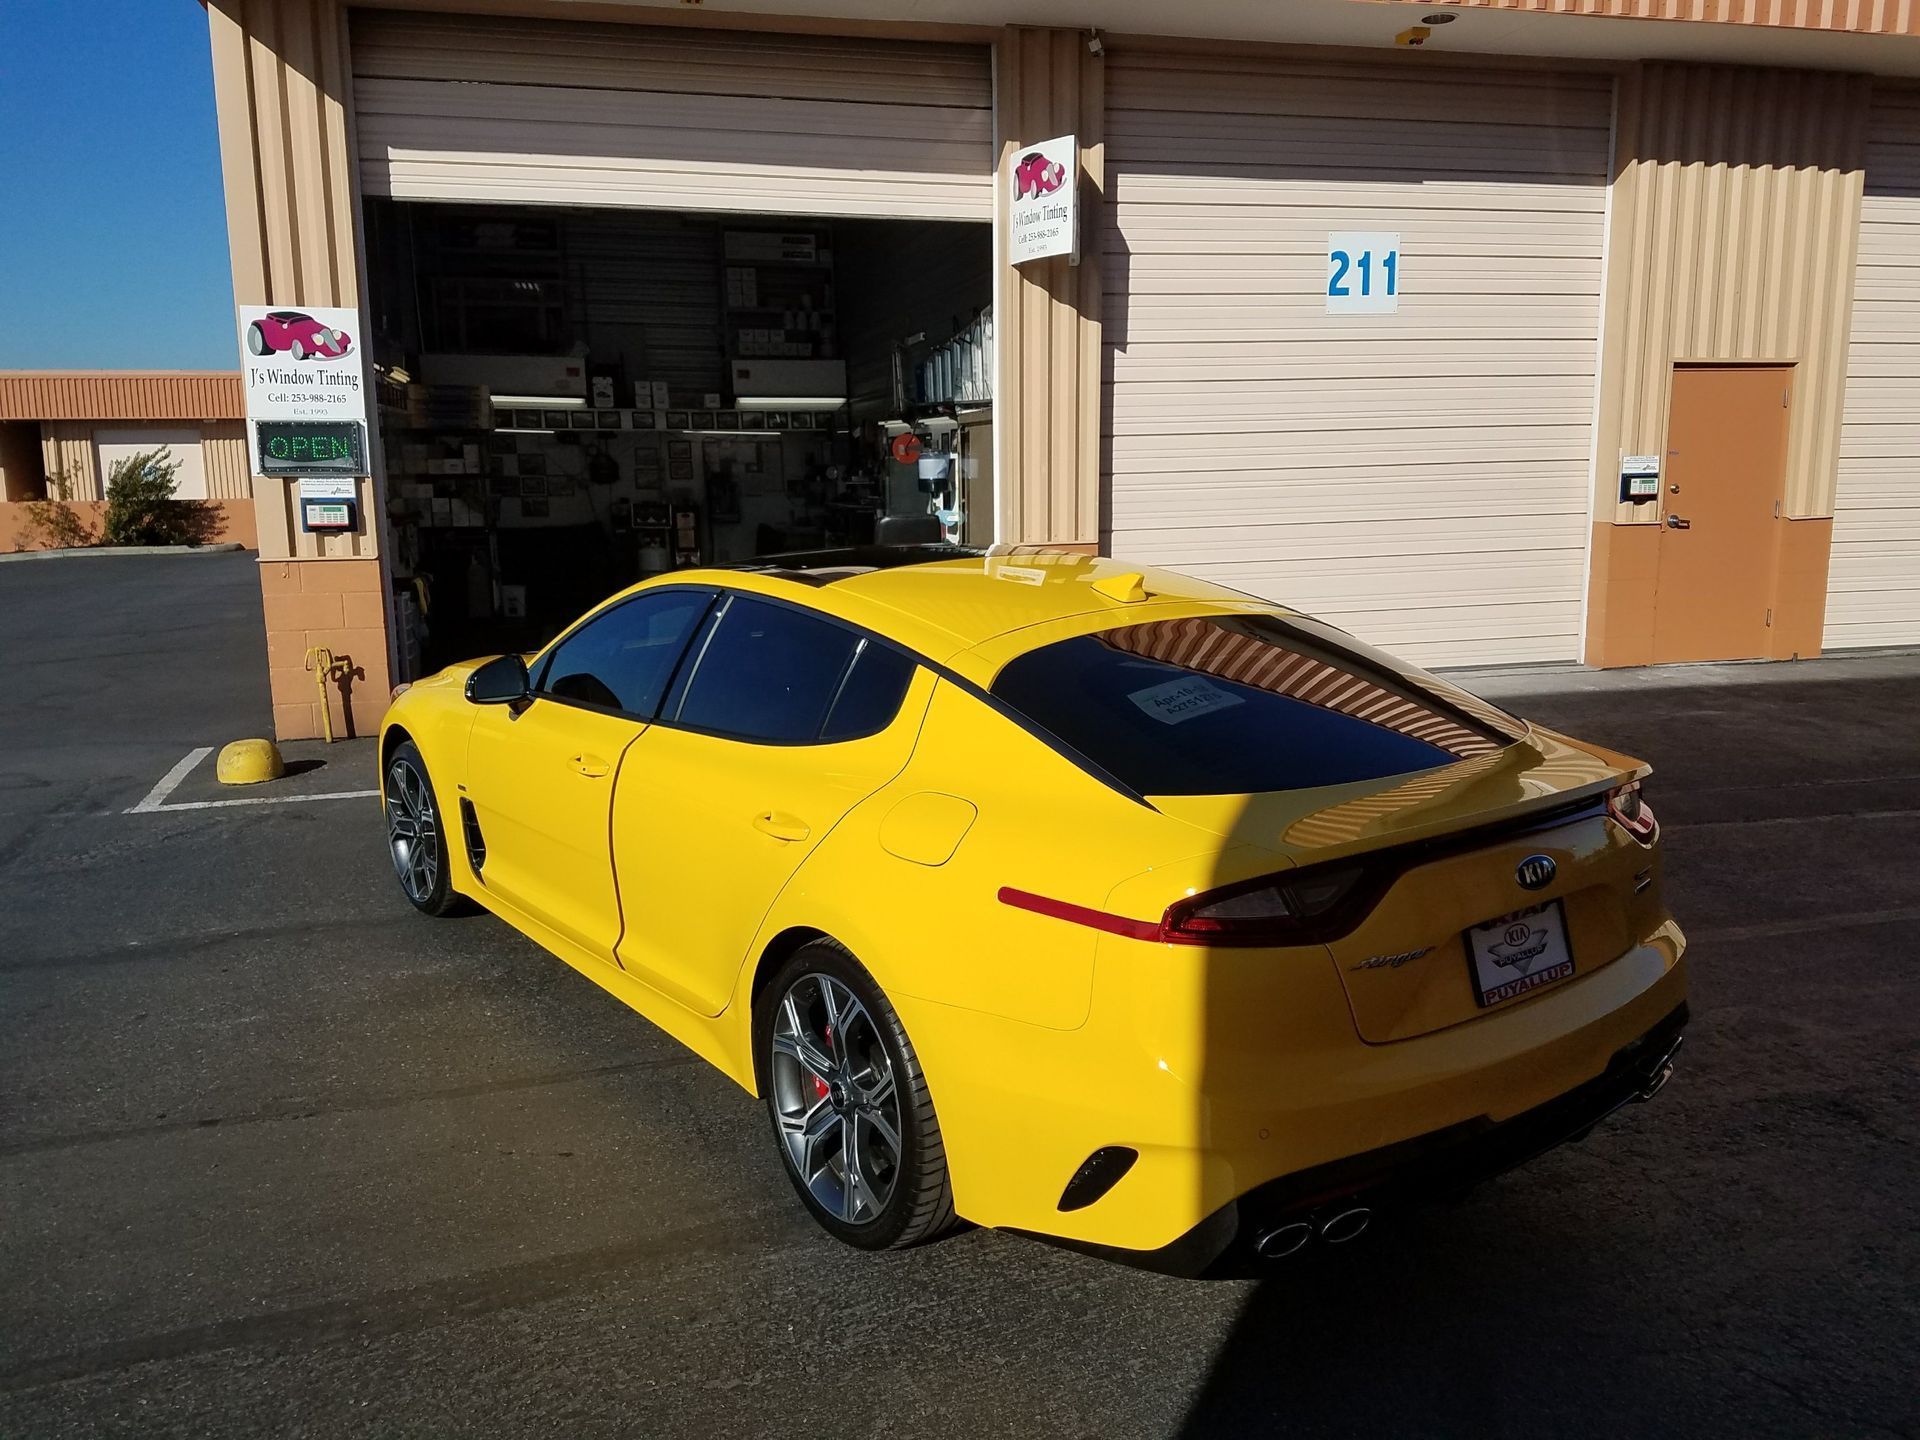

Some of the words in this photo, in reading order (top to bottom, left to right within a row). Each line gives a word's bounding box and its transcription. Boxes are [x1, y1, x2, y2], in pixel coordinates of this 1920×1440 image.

[1019, 208, 1041, 227] Window
[1042, 203, 1068, 222] Tinting
[1328, 250, 1397, 296] 211
[250, 367, 265, 388] J's
[267, 368, 315, 385] Window
[316, 369, 359, 391] Tinting
[267, 393, 289, 403] Cell:
[291, 393, 347, 403] 253-988-2165
[270, 436, 349, 459] OPEN
[1521, 862, 1553, 884] KIA
[1507, 927, 1527, 944] KIA
[1499, 945, 1545, 967] PUYALLUP
[1486, 964, 1571, 1005] PUYALLUP
